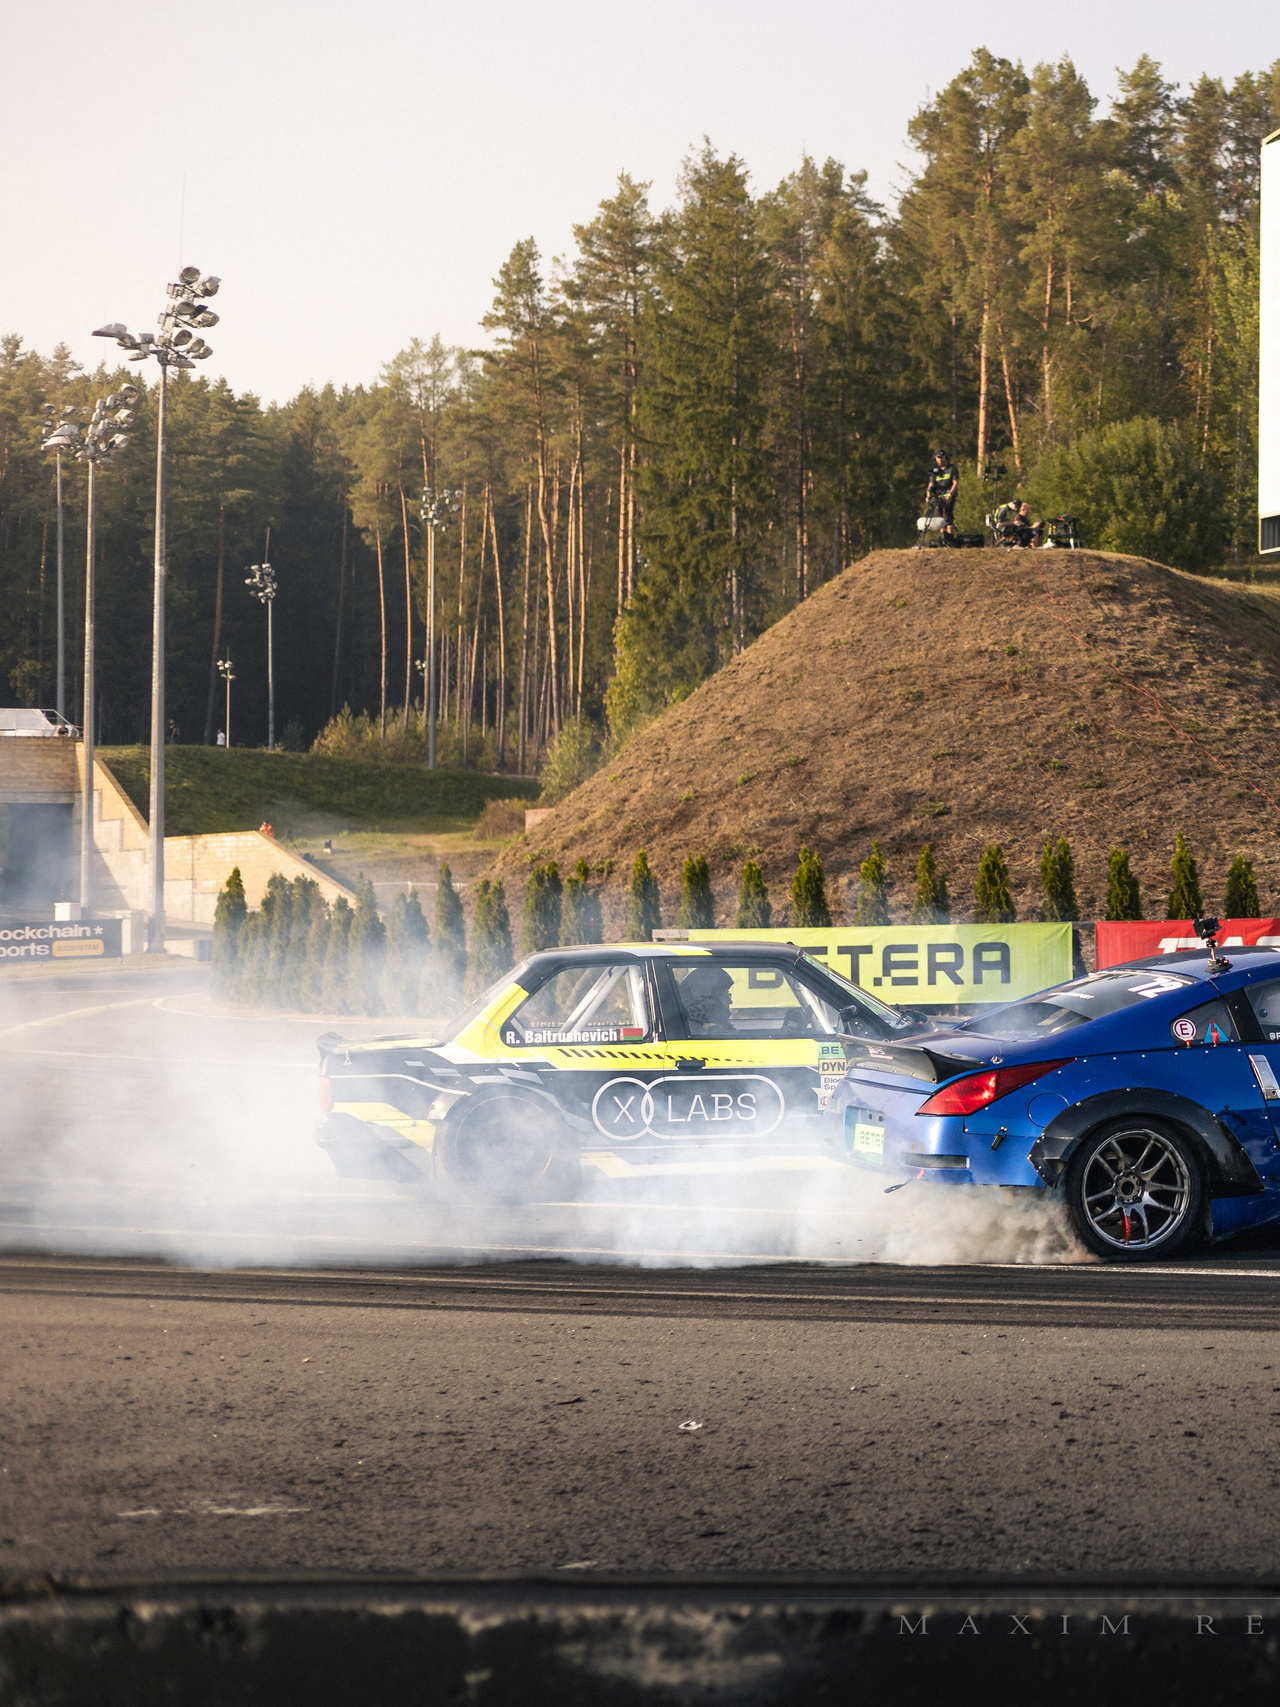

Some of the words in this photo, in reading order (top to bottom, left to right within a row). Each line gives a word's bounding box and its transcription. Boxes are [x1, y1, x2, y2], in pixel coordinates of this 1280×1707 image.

[0, 924, 91, 941] ockchain
[57, 944, 99, 952] ECOSYSTEM
[505, 1030, 521, 1044] R.
[524, 1028, 618, 1044] Baltrushevich
[821, 1046, 843, 1055] BE
[821, 1062, 847, 1072] DYN
[612, 1095, 636, 1124] X
[667, 1093, 758, 1122] LABS
